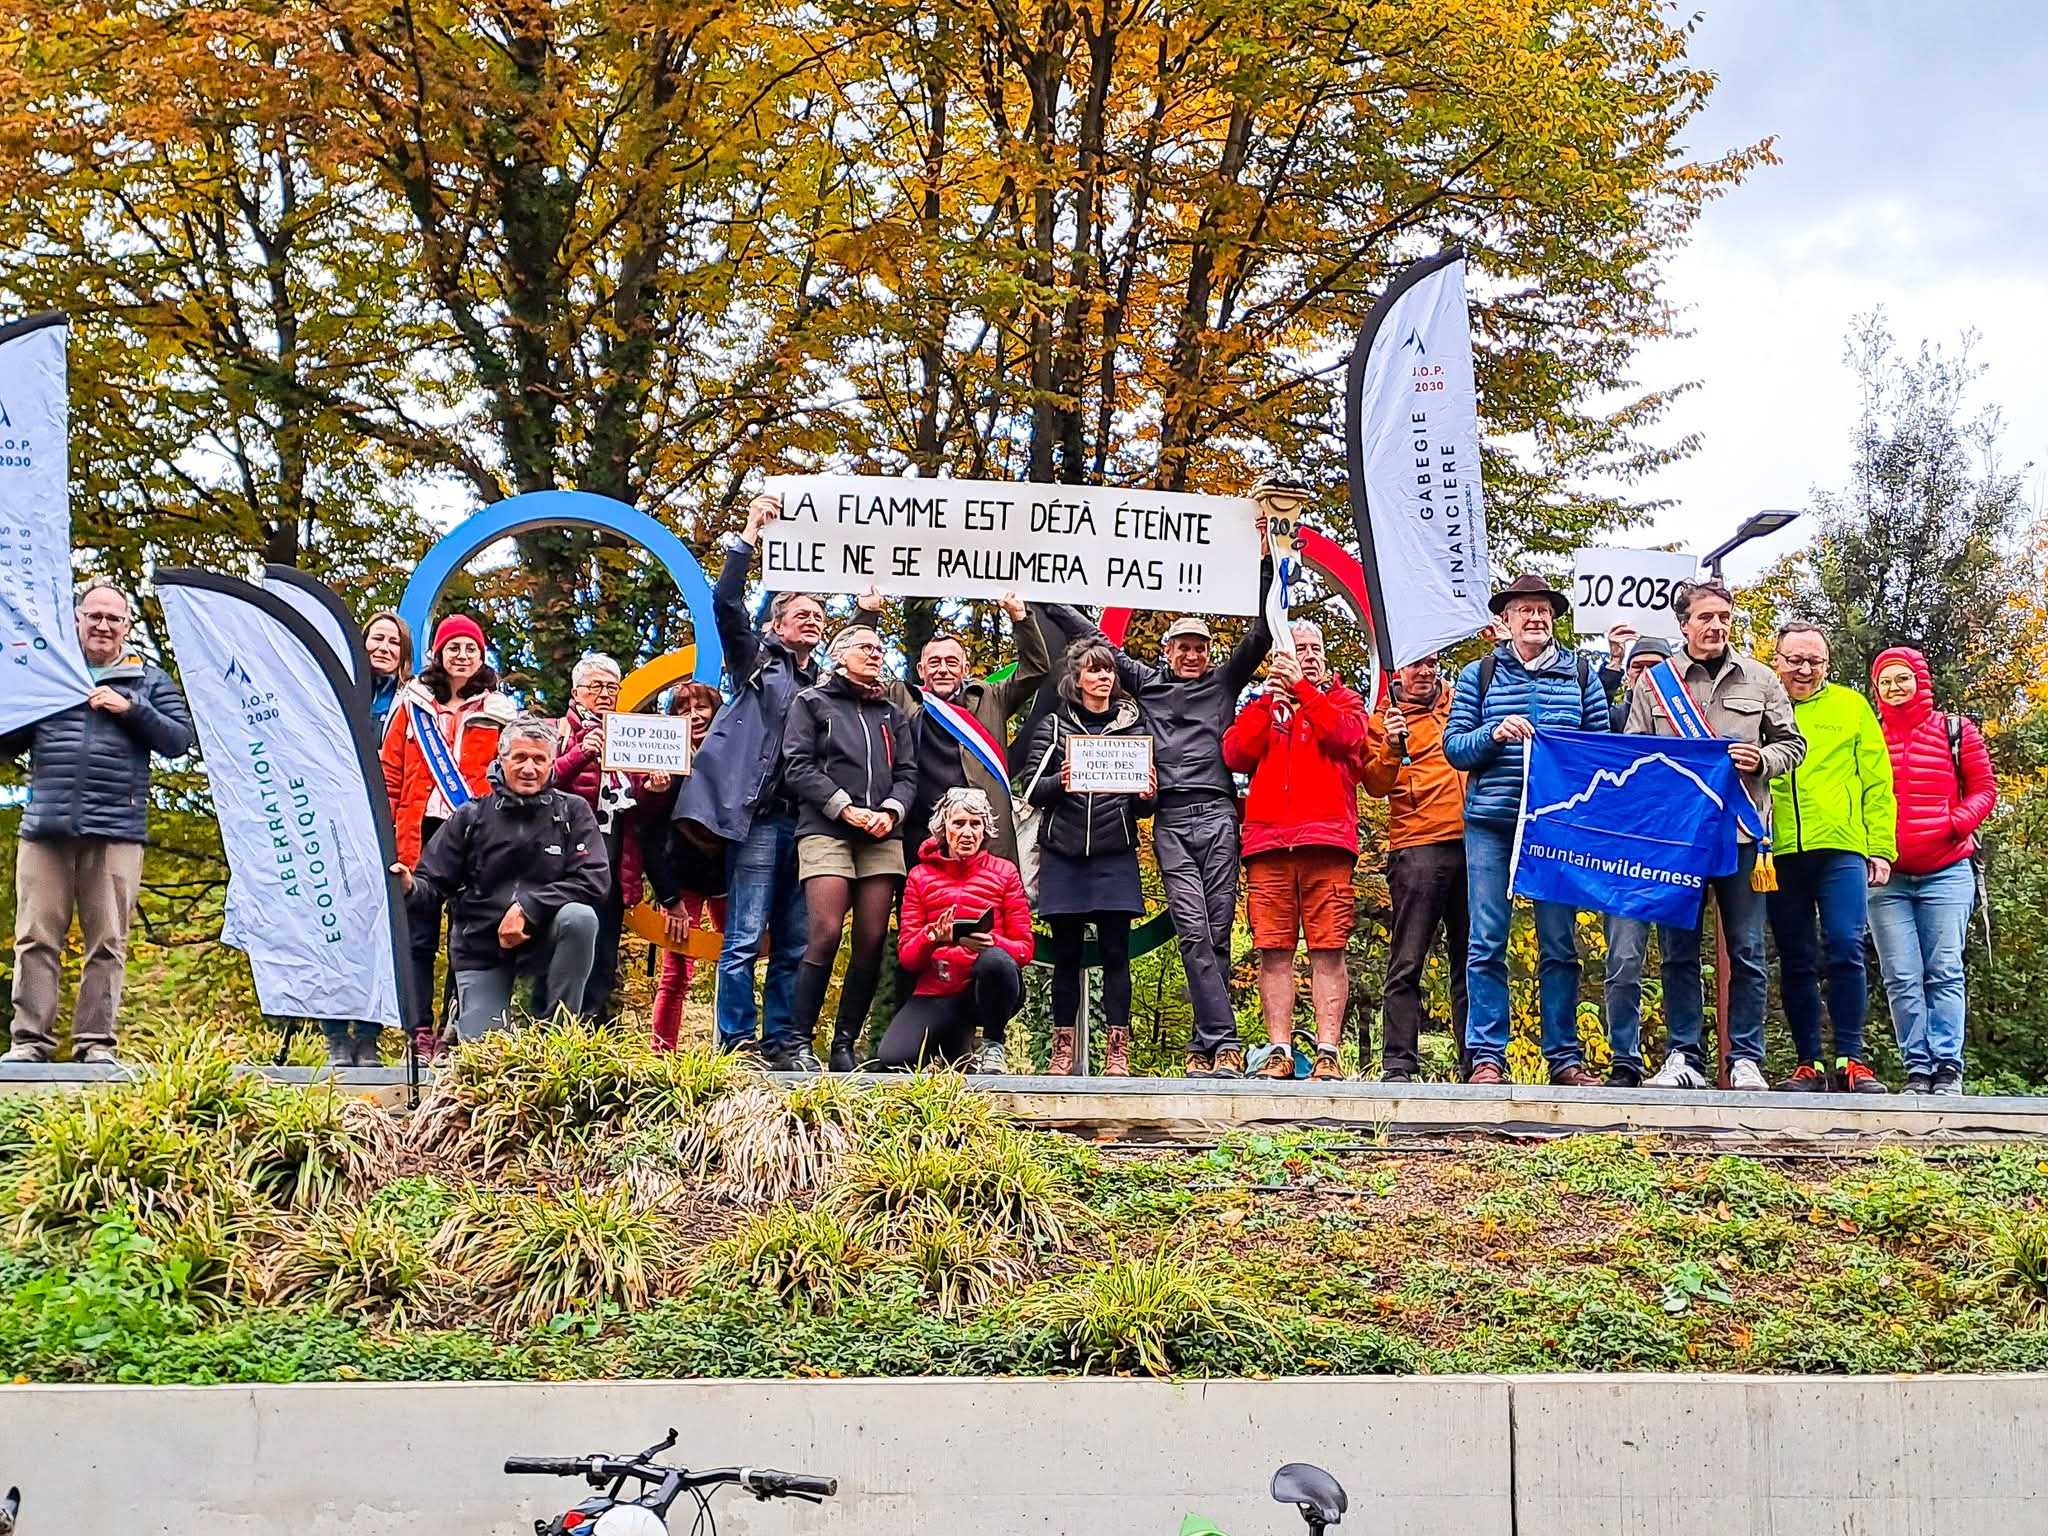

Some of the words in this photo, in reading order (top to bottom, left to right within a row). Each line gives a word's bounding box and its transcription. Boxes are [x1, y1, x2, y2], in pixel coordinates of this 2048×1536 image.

[1412, 365, 1444, 377] J.O.P.
[1415, 381, 1443, 392] 2030
[0, 439, 33, 450] .O.P.
[1412, 412, 1434, 520] GABEGIE
[779, 492, 818, 522] LA
[838, 494, 948, 529] FLAMME
[965, 499, 1015, 531] EST
[1030, 498, 1097, 536] DÉJÀ
[1114, 501, 1213, 545] ÉTEINTE
[1441, 445, 1467, 599] FINANCIERE
[768, 540, 826, 573] ELLE
[842, 543, 876, 575] NE
[891, 546, 922, 577] SE
[937, 547, 1088, 586] RALLUMERA
[1107, 557, 1163, 591] PAS
[1178, 562, 1202, 593] !!!
[241, 692, 278, 710] J.O.P.
[247, 708, 279, 725] 2030
[1096, 740, 1146, 749] CITOYENS
[613, 752, 631, 762] UN
[1086, 760, 1109, 770] QUE
[1114, 761, 1134, 769] DES
[1071, 771, 1148, 780] SPECTATEURS
[248, 740, 301, 897] ABERRATION
[288, 776, 342, 944] ECOLOGIQUE
[1528, 843, 1702, 889] mountainwilderness
